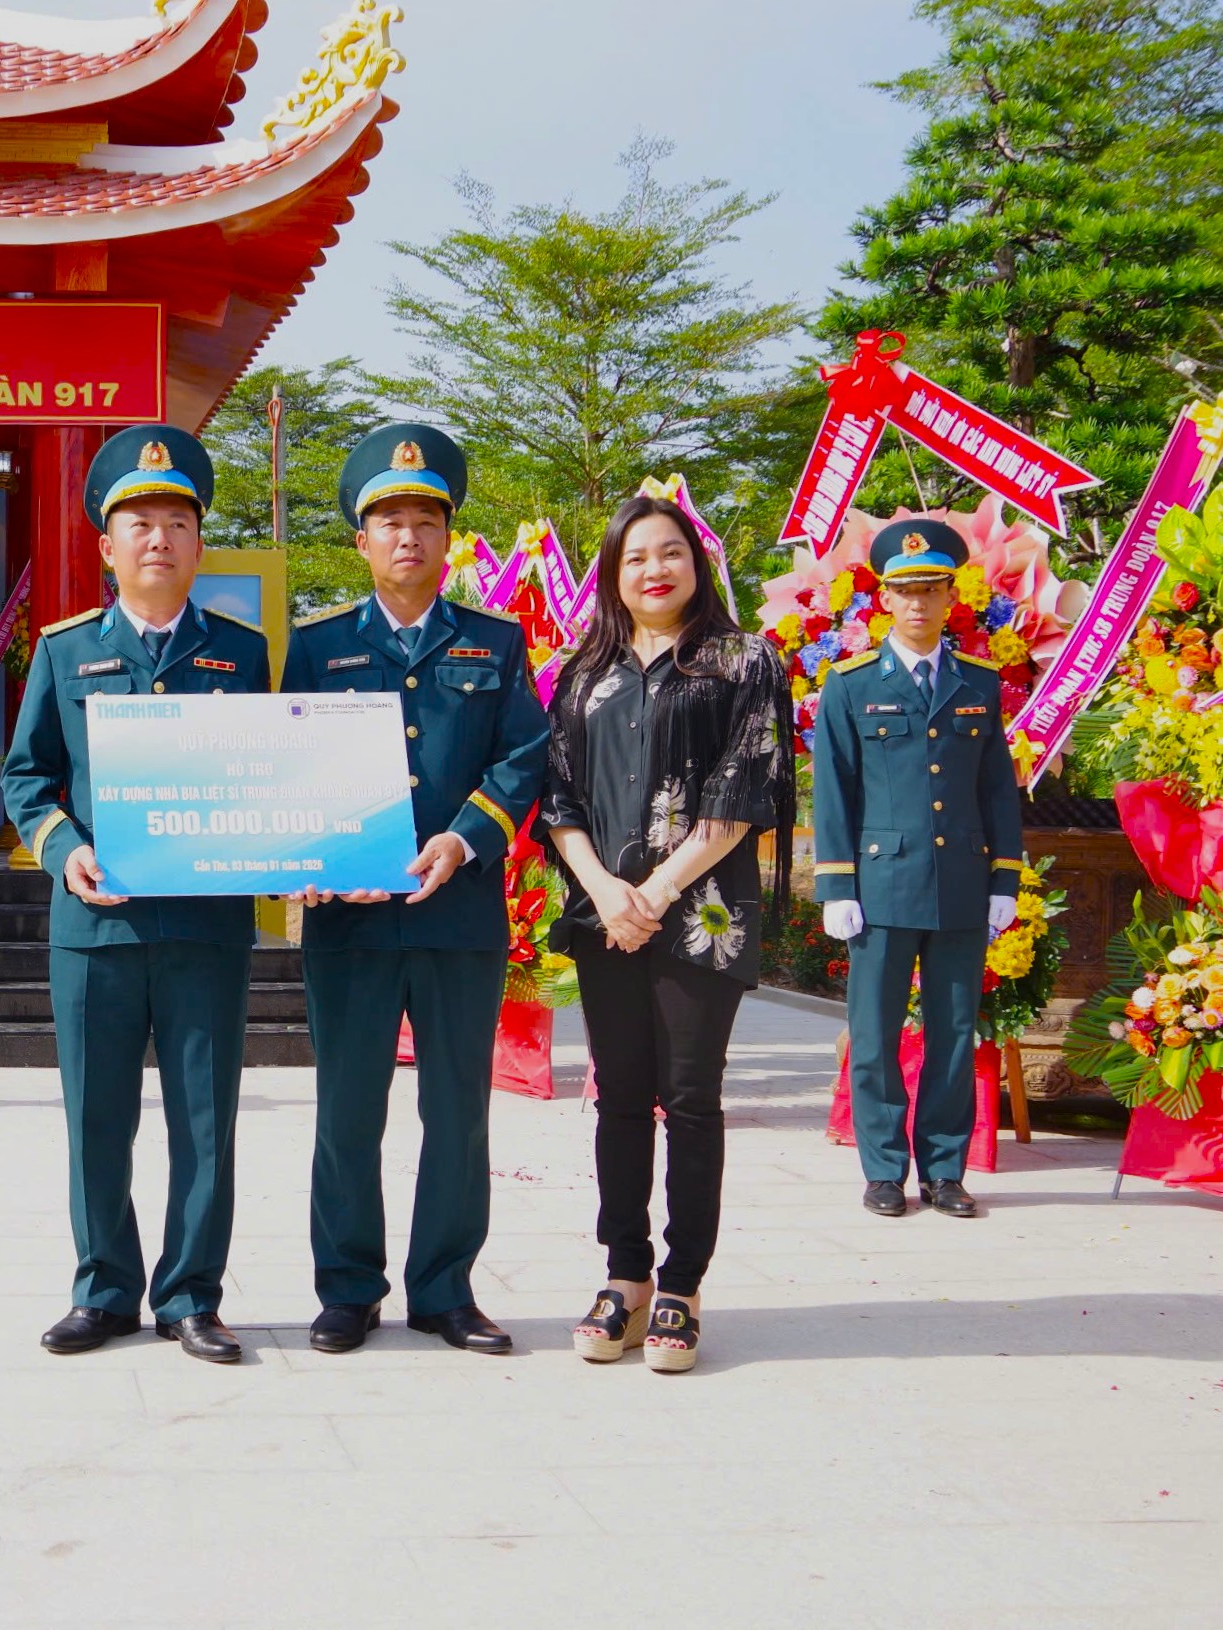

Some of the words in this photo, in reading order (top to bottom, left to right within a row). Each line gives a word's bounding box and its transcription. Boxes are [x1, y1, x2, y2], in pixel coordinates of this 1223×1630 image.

[55, 382, 120, 408] 917
[1101, 573, 1137, 618] TRUNG
[98, 785, 119, 801] XÂY
[156, 785, 178, 801] NHÀ
[182, 786, 199, 800] BIA
[203, 784, 224, 803] LIỆT
[146, 810, 326, 836] 500.000.000
